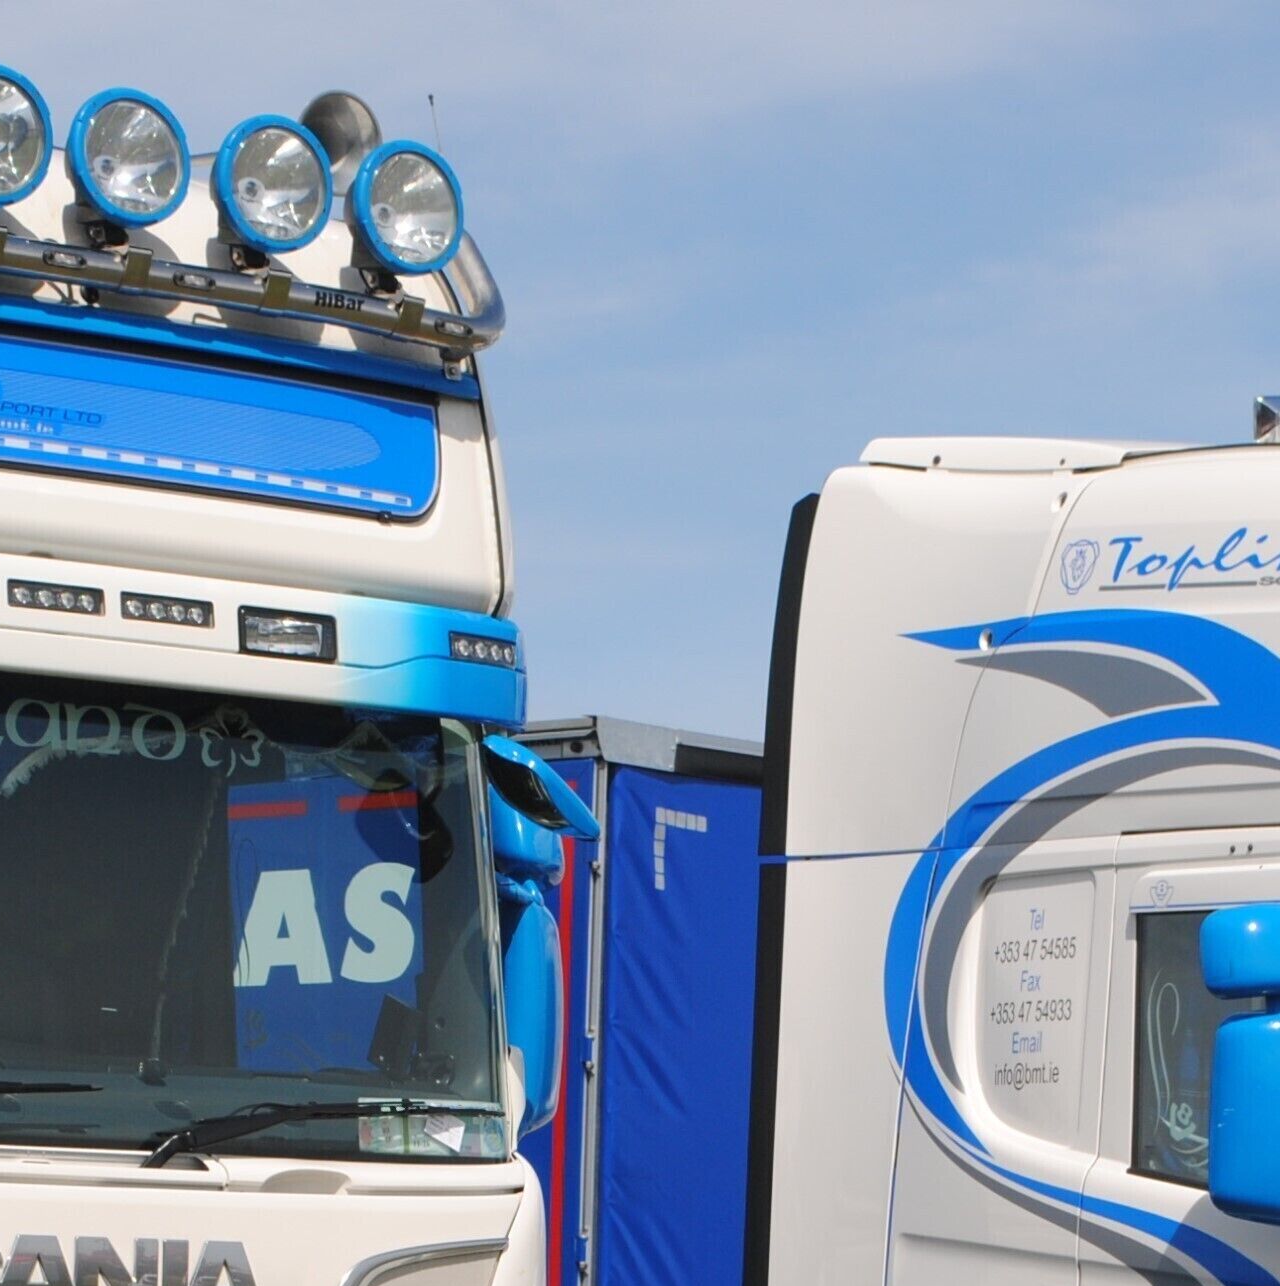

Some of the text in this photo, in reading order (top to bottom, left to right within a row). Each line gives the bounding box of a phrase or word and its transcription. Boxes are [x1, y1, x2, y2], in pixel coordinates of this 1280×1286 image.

[64, 409, 102, 425] LTD
[234, 862, 415, 987] AS
[1030, 908, 1044, 931] Tel
[995, 936, 1076, 964] +353 47 54585
[1020, 970, 1041, 992] Fax
[990, 999, 1072, 1025] +353 47 54933
[1011, 1031, 1043, 1055] Email
[994, 1062, 1059, 1091] info@bmt.ie
